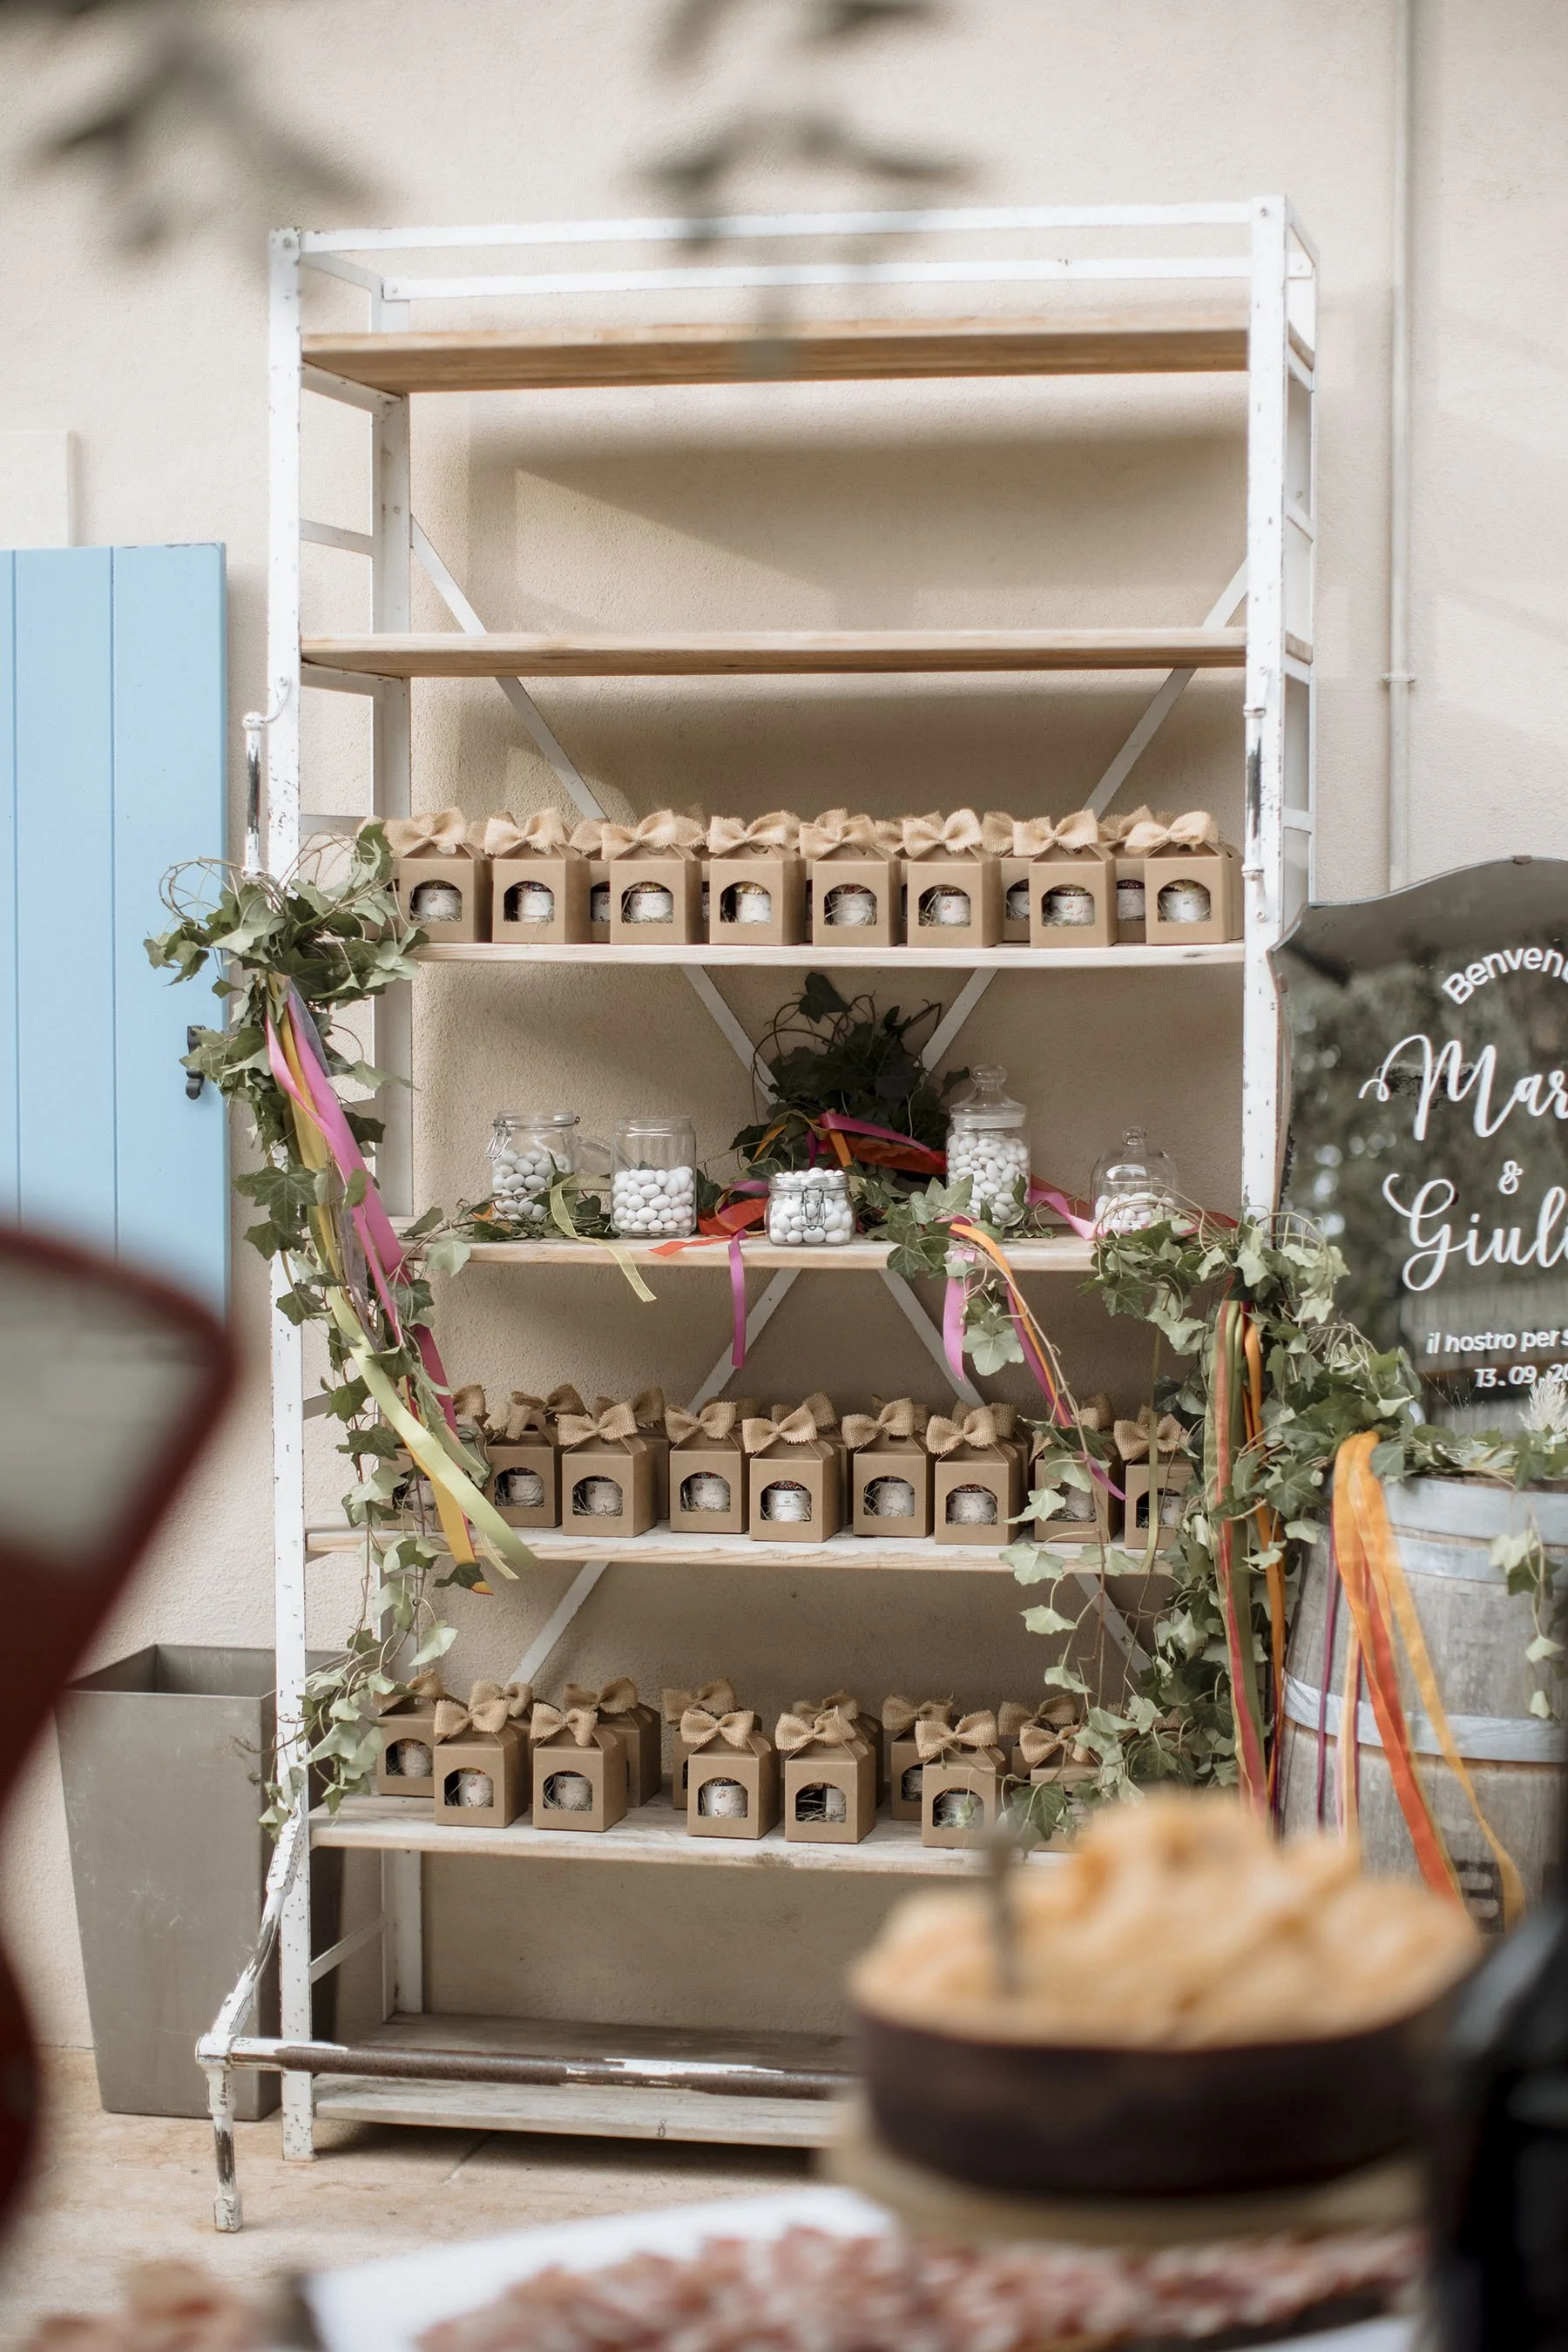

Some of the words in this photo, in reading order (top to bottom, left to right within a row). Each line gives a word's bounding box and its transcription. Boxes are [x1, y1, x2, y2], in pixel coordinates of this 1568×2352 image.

[1497, 1160, 1523, 1194] &
[1382, 1173, 1568, 1291] Giul
[1426, 1332, 1441, 1354] il
[1443, 1332, 1517, 1353] nostro
[1520, 1329, 1560, 1352] per
